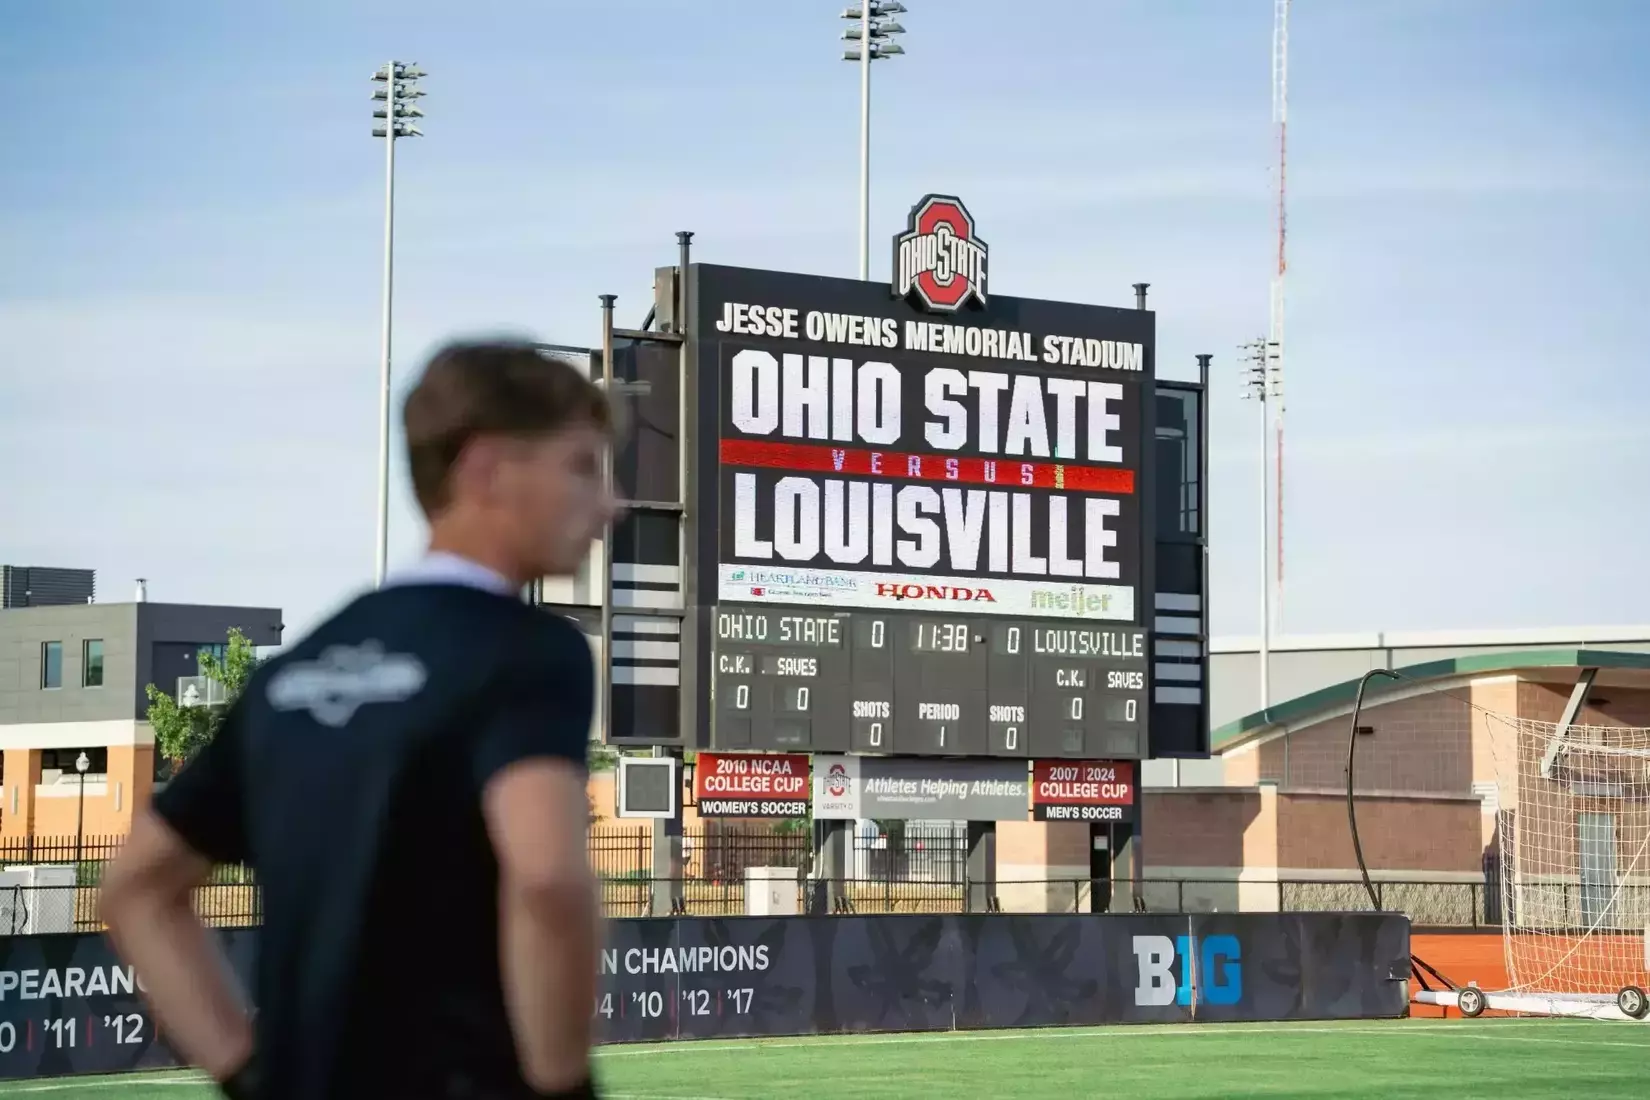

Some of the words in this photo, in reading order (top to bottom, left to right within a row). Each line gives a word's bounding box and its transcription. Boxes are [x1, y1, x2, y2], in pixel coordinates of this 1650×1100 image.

[900, 234, 937, 295] OHIO
[937, 228, 986, 304] STATE
[717, 302, 798, 338] JESSE
[806, 311, 897, 348] OWENS
[905, 321, 1037, 361] MEMORIAL
[1044, 335, 1143, 371] STADIUM
[732, 349, 900, 445] OHIO
[925, 367, 1123, 463] STATE
[832, 449, 1034, 485] VERSUS
[735, 473, 1120, 579] LOUISVILLE
[874, 583, 997, 602] HONDA
[1031, 586, 1113, 616] meijer
[719, 614, 767, 639] OHIO
[780, 617, 839, 643] STATE
[871, 621, 884, 648] 0
[917, 624, 968, 651] 11:38
[1007, 627, 1020, 653] 0
[1034, 629, 1143, 657] LOUISVILLE
[720, 656, 750, 674] C.K.
[777, 658, 817, 676] SAVES
[1056, 669, 1084, 687] C.K.
[1107, 671, 1143, 689] SAVES
[736, 685, 748, 709] 0
[797, 687, 809, 711] 0
[1072, 697, 1083, 720] 0
[853, 701, 889, 718] SHOTS
[919, 703, 959, 720] PERIOD
[989, 705, 1024, 722] SHOTS
[1125, 699, 1137, 722] 0
[870, 723, 882, 746] 0
[940, 726, 945, 747] 1
[1006, 727, 1017, 750] 0
[716, 759, 747, 775] 2010
[752, 760, 792, 775] NCAA
[1050, 767, 1078, 781] 2007
[1087, 768, 1115, 781] 2024
[705, 776, 770, 792] COLLEGE
[774, 778, 803, 792] CUP
[865, 778, 917, 793] Athletes
[920, 779, 968, 799] Helping
[1040, 782, 1097, 797] COLLEGE
[1102, 785, 1128, 798] CUP
[702, 801, 759, 814] WOMEN'S
[761, 802, 806, 815] SOCCER
[1046, 806, 1079, 818] MEN'S
[1082, 807, 1122, 819] SOCCER
[624, 945, 770, 974] CHAMPIONS
[632, 991, 663, 1018] '10
[683, 989, 710, 1016] '12
[727, 988, 754, 1014] '17
[43, 1017, 76, 1048] '11
[104, 1013, 144, 1044] '12
